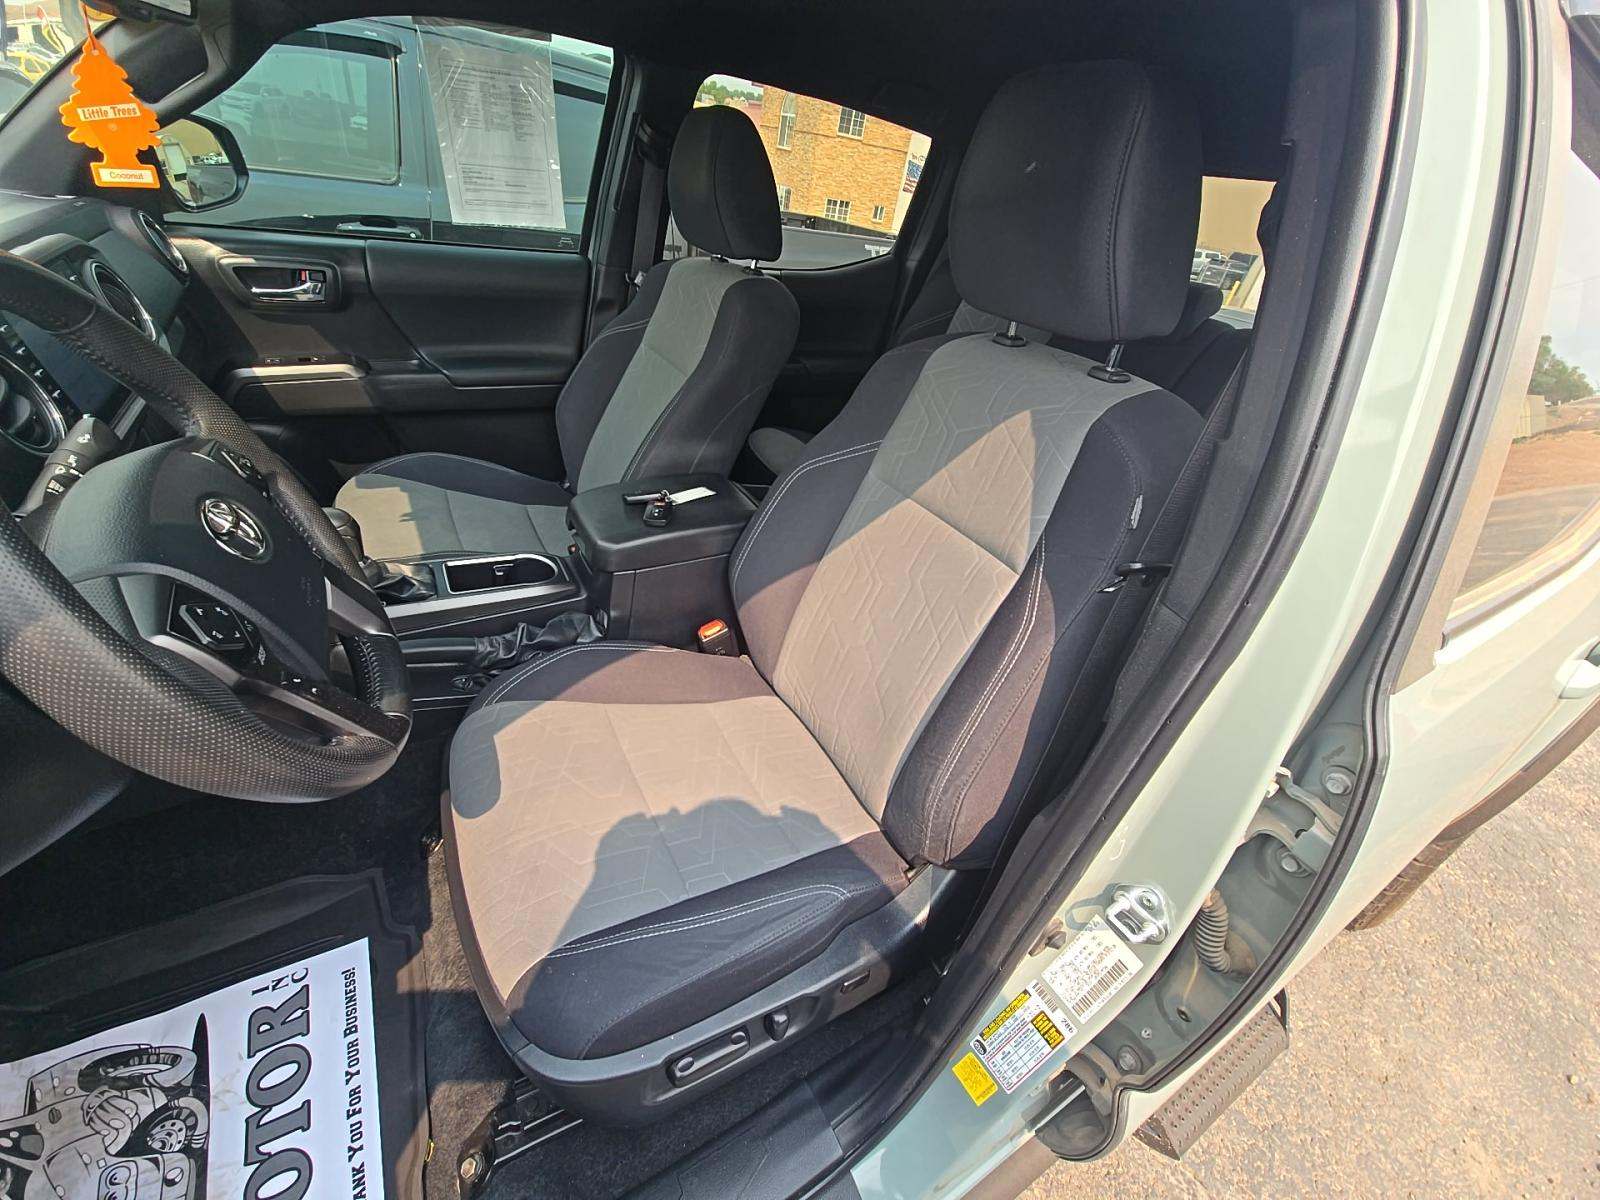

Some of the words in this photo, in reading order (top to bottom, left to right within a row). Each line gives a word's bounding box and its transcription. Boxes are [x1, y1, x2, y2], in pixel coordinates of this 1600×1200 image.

[82, 107, 108, 120] Little
[110, 105, 138, 117] Trees
[109, 171, 144, 180] Coconut
[341, 966, 359, 1039] BUSINESS!
[344, 1037, 361, 1086] YOUR
[346, 1084, 363, 1121] FOR
[347, 1120, 364, 1163] YOU
